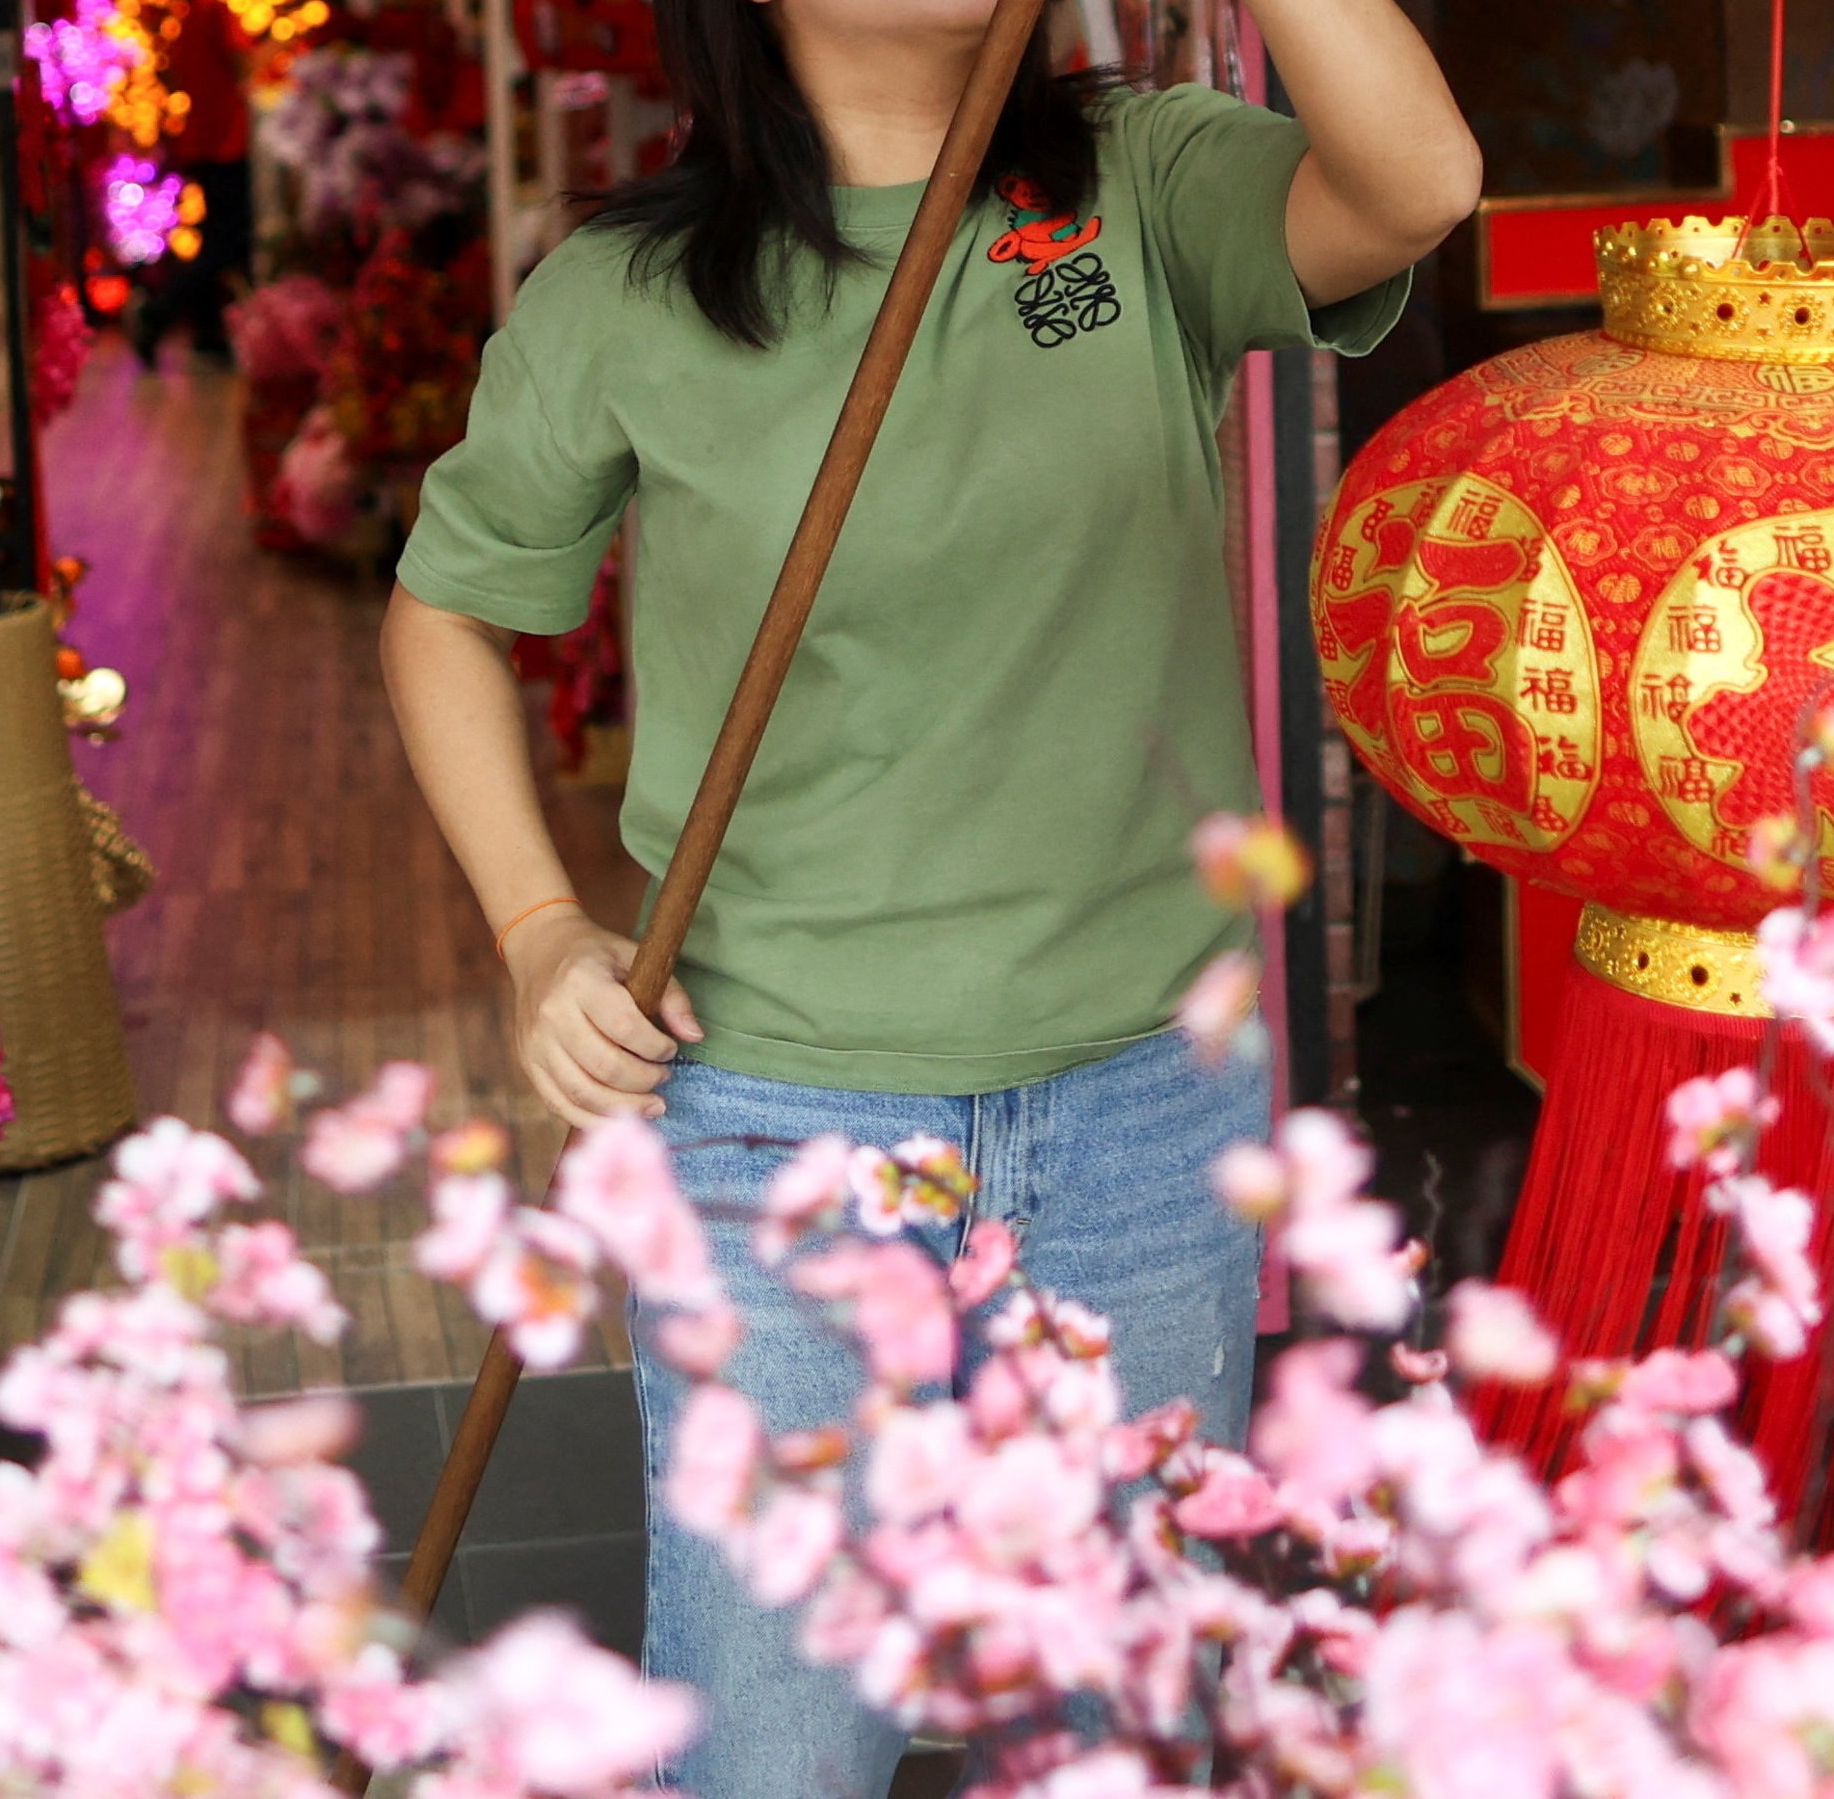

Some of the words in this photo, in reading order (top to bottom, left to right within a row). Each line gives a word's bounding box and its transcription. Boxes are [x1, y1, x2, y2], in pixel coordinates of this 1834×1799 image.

[1451, 490, 1504, 541] 福
[1516, 598, 1571, 654] 福
[1520, 666, 1579, 715] 福
